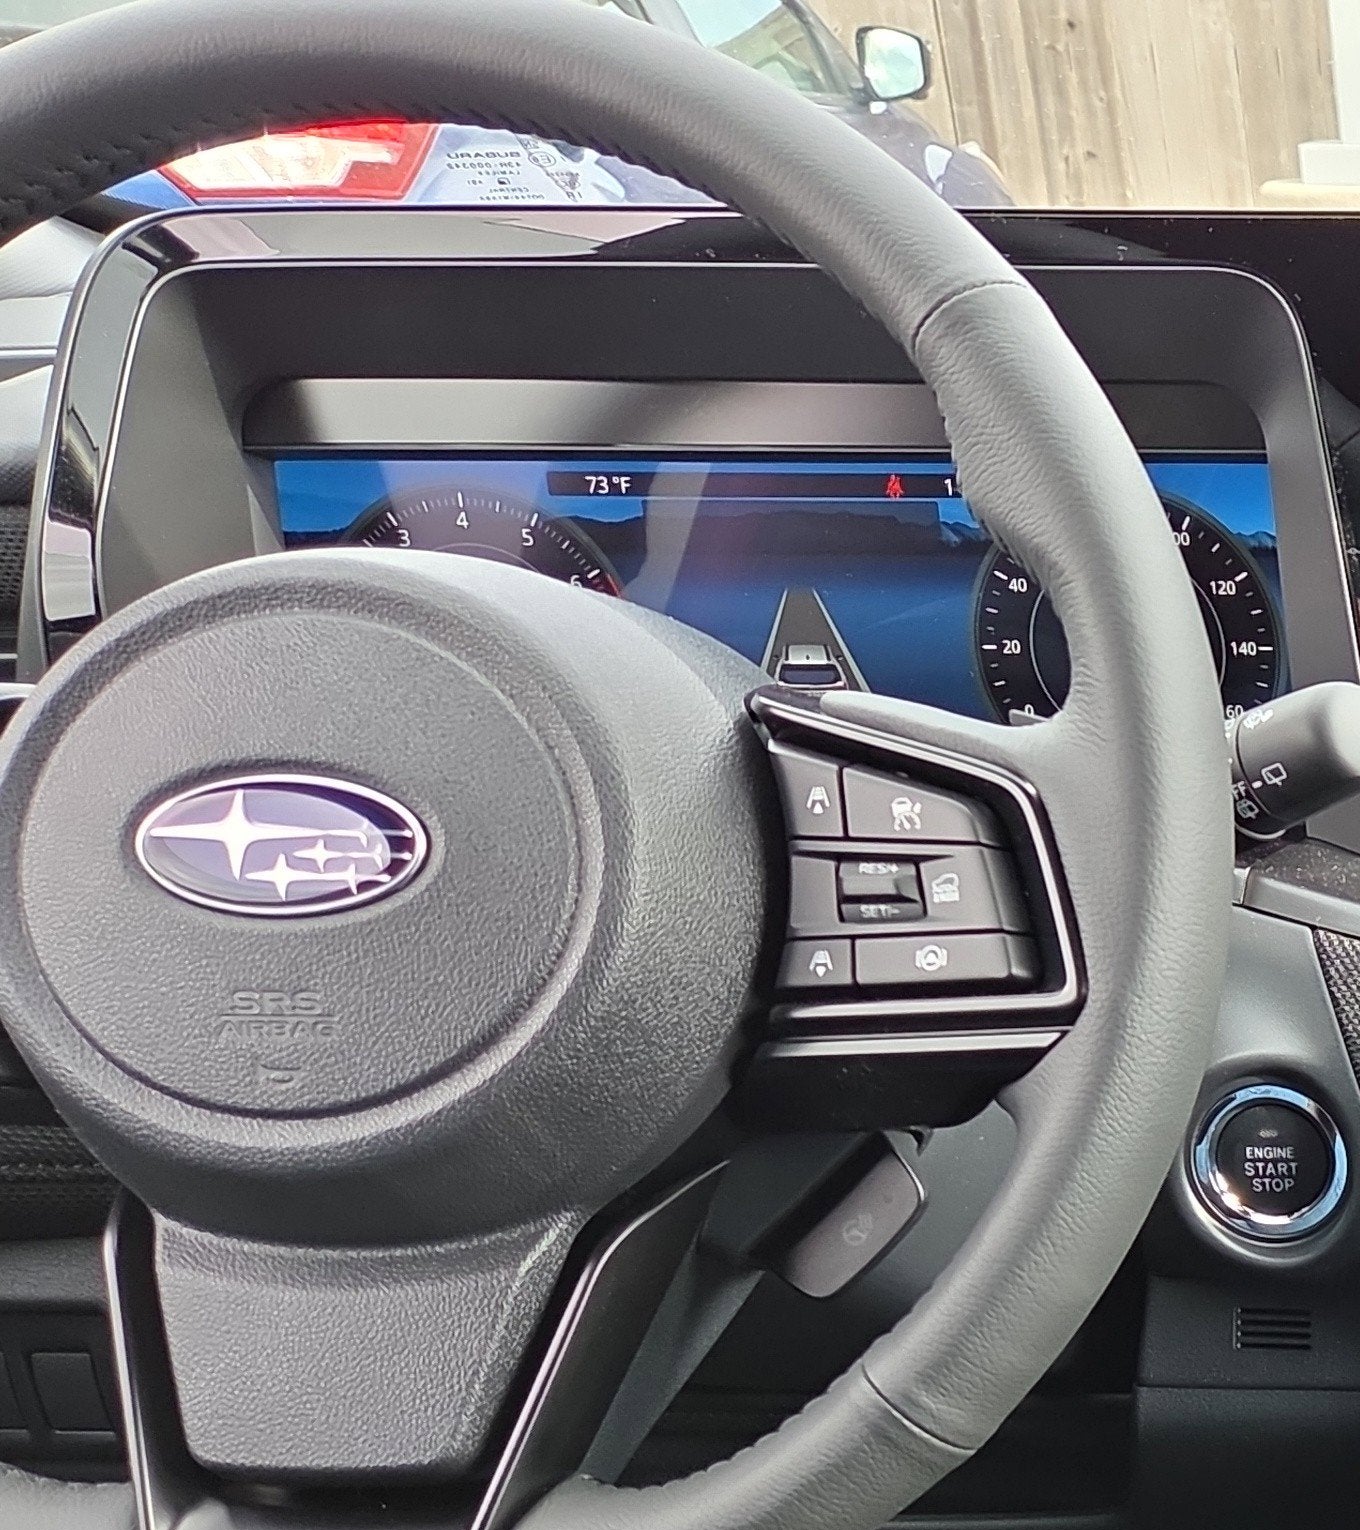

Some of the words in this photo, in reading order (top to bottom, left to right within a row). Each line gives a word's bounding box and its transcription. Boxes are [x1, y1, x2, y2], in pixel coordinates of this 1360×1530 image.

[584, 476, 632, 494] 73°F
[456, 510, 469, 529] 4
[400, 529, 411, 547] 3
[522, 528, 534, 546] 5
[1172, 532, 1190, 546] 00
[1008, 578, 1028, 592] 40
[1209, 580, 1237, 596] 120
[1002, 641, 1021, 655] 20
[1230, 641, 1258, 656] 140
[1226, 704, 1244, 718] 60
[1232, 780, 1246, 801] FF
[1246, 1146, 1295, 1160] ENGINE
[1244, 1162, 1298, 1176] START
[1252, 1178, 1295, 1193] STOP
